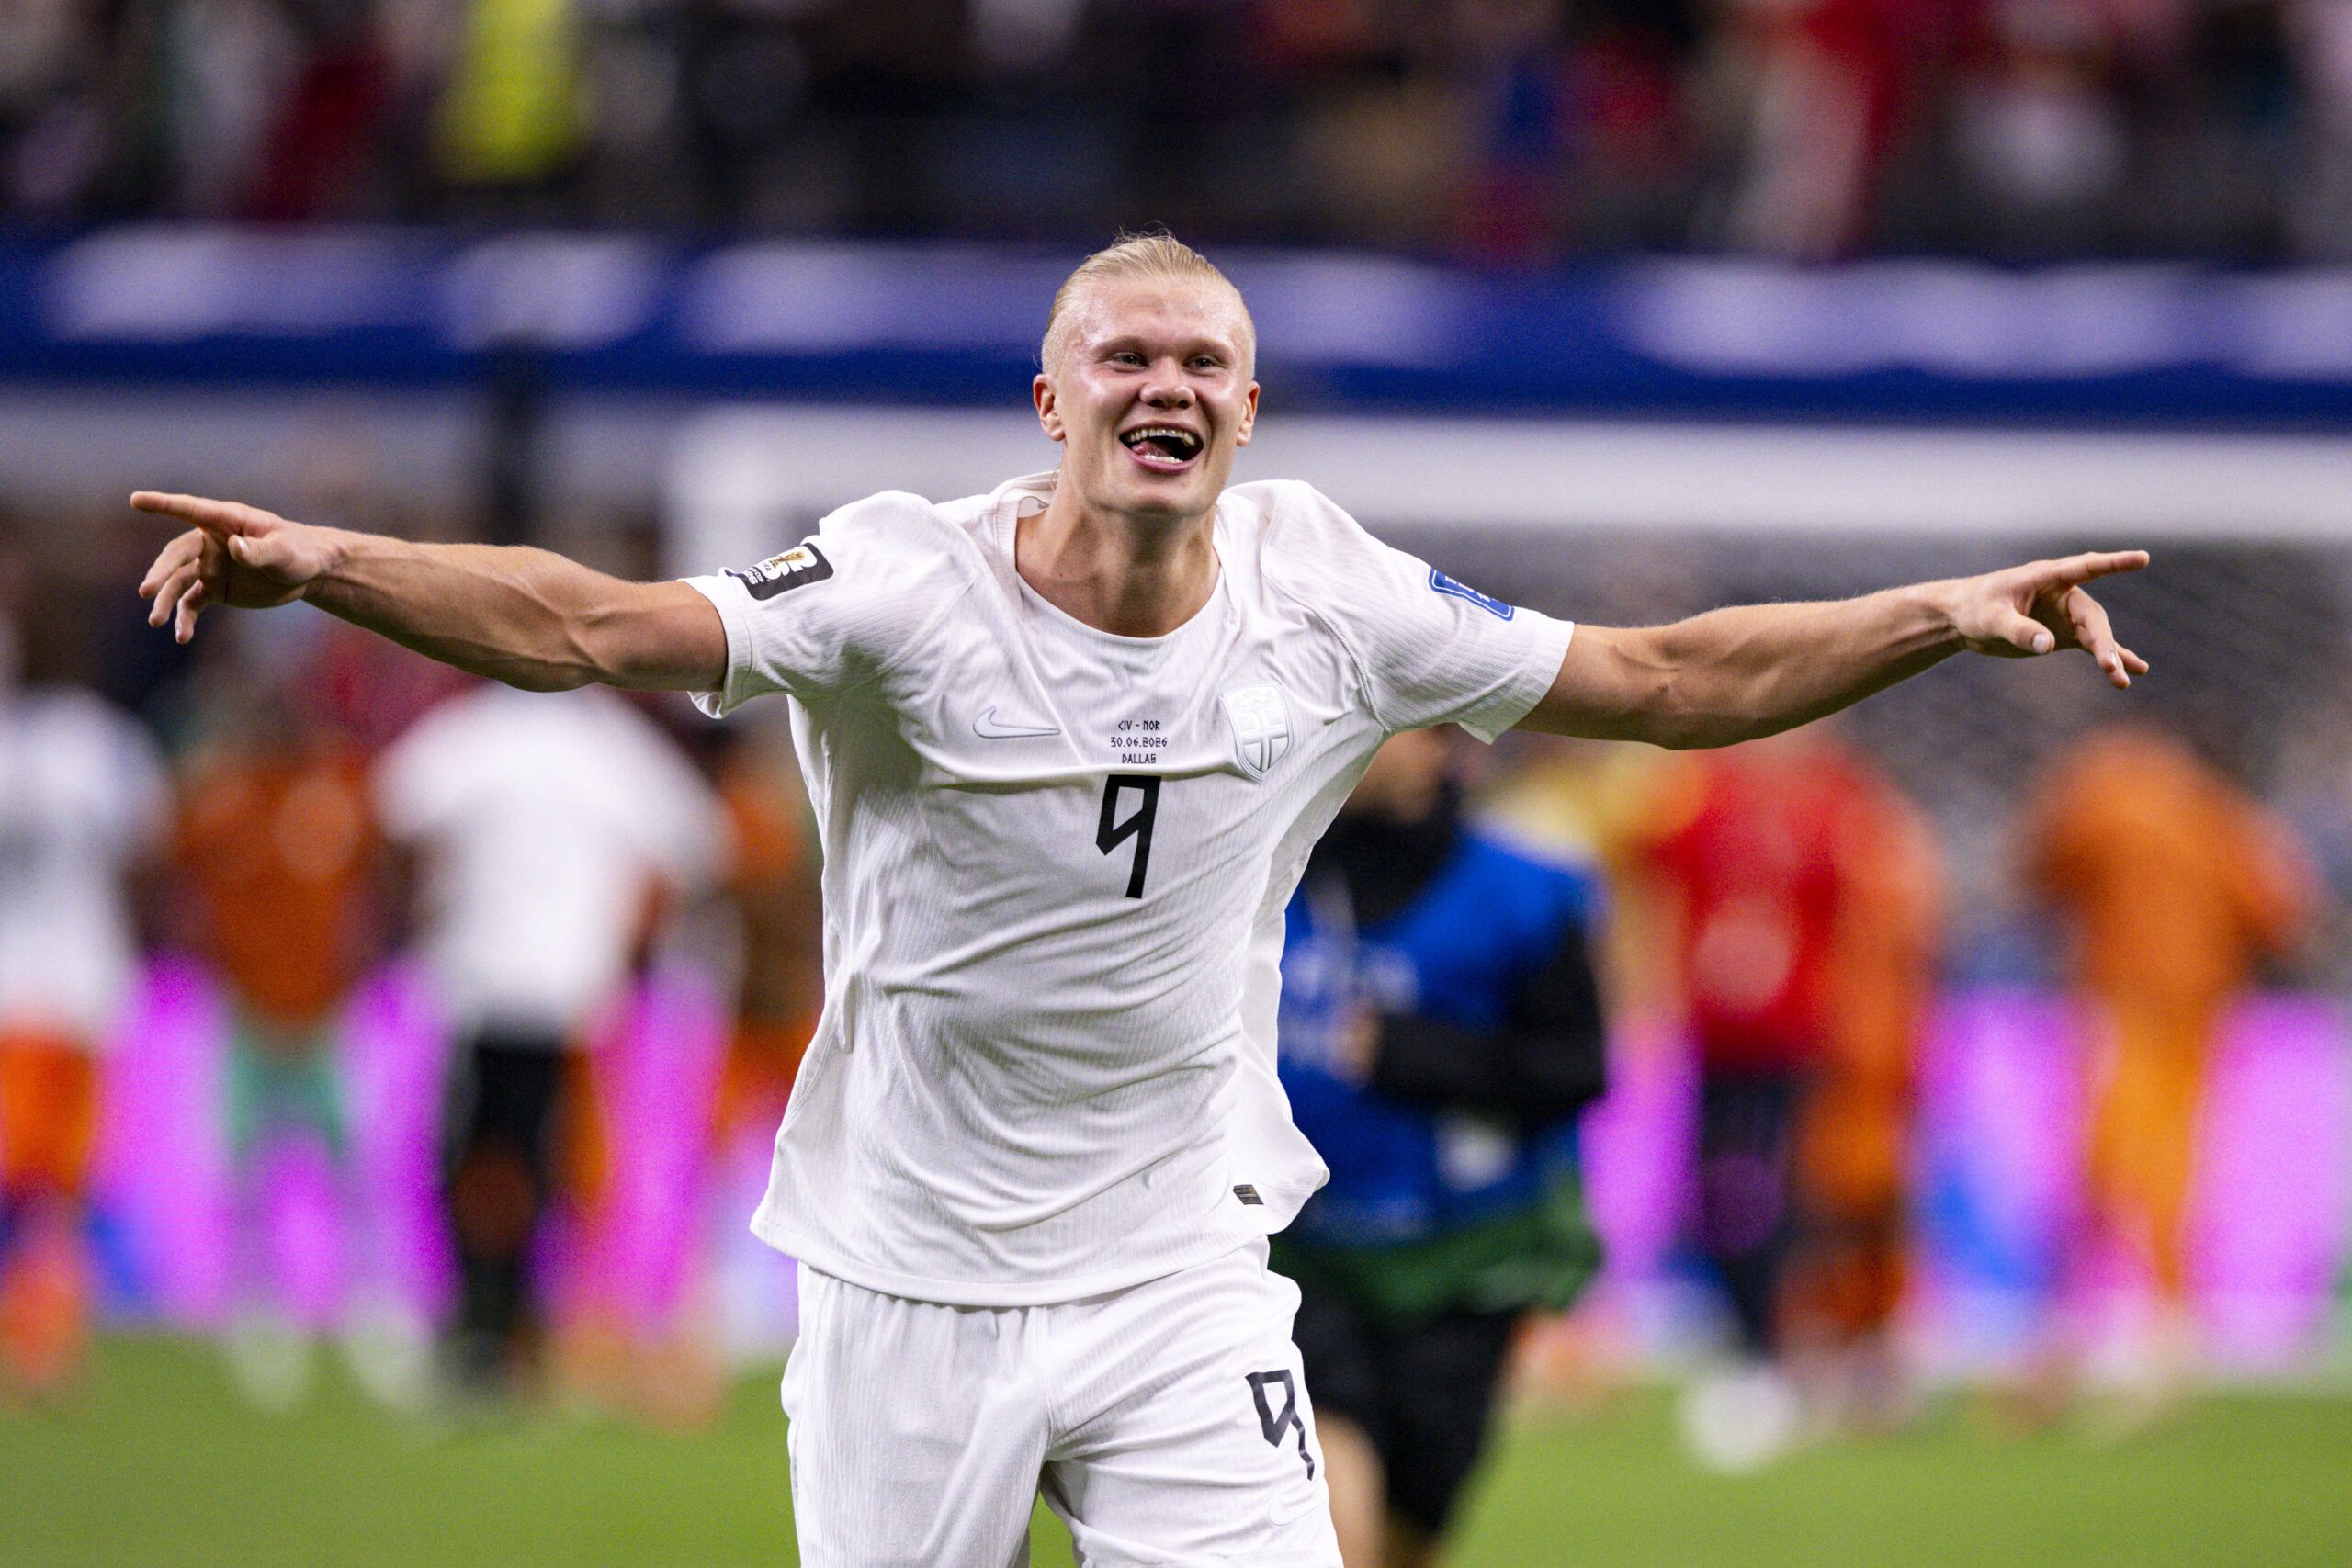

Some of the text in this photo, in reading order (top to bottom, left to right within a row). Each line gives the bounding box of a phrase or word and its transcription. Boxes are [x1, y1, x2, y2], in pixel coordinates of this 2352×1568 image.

[1117, 720, 1132, 731] CIV
[1143, 720, 1161, 731] NOR
[1110, 737, 1168, 748] 30.06.2026
[1122, 753, 1157, 764] DALLAS
[1095, 774, 1162, 899] 9
[1244, 1369, 1315, 1482] 9
